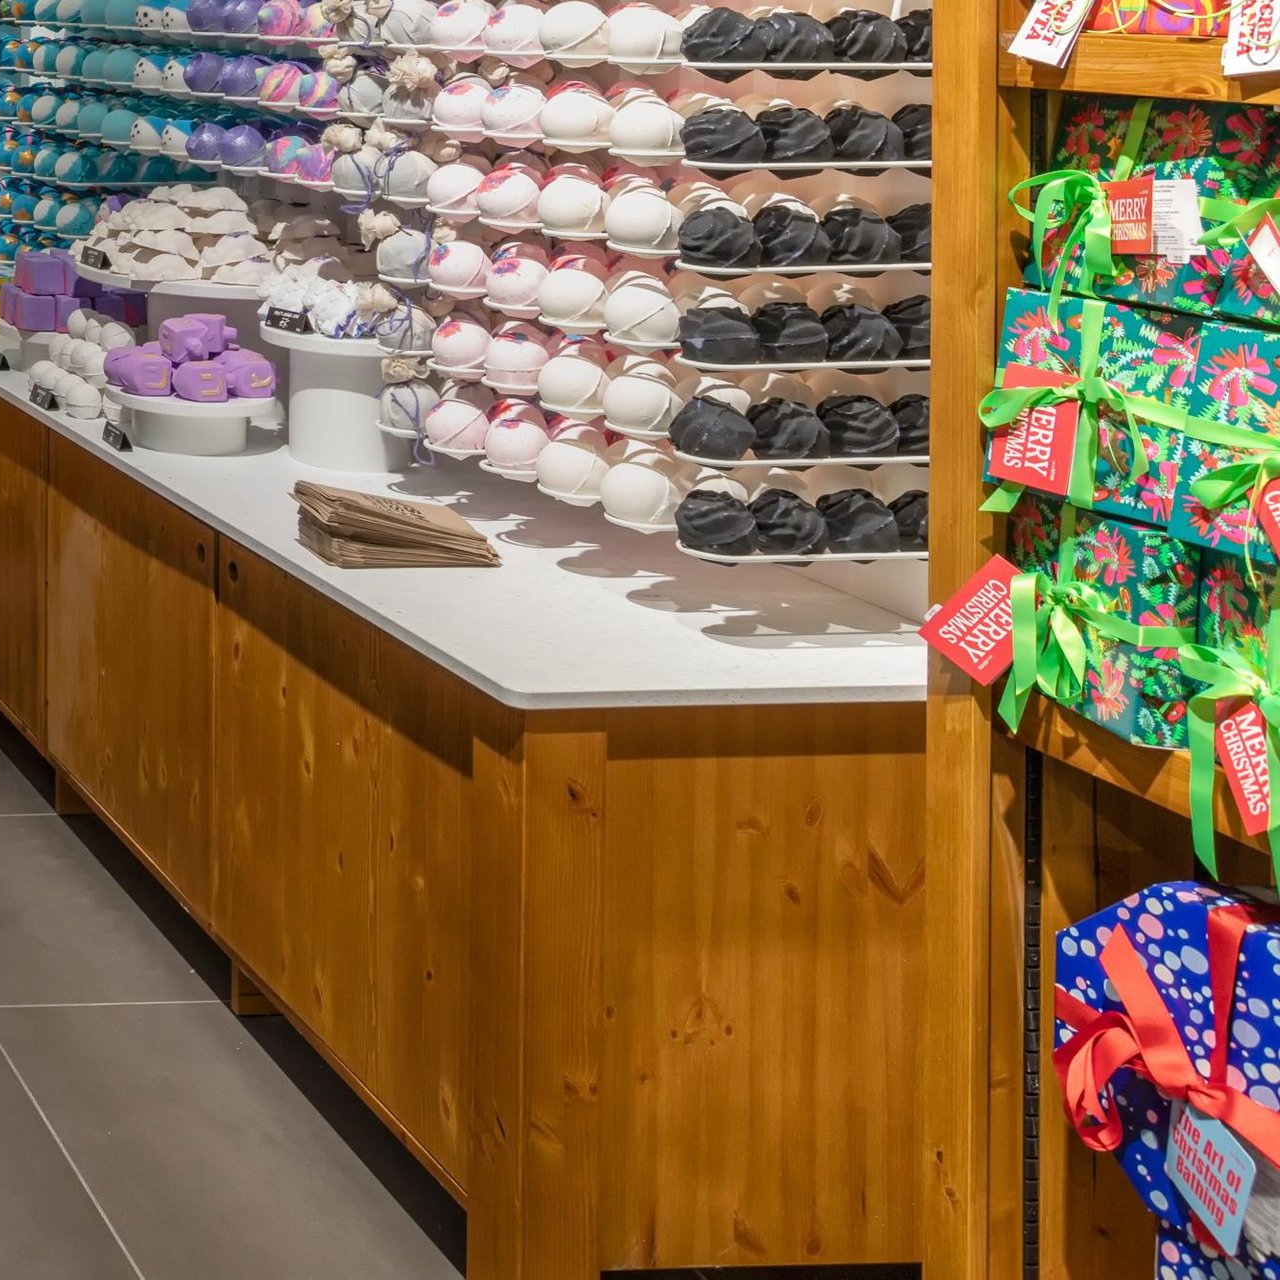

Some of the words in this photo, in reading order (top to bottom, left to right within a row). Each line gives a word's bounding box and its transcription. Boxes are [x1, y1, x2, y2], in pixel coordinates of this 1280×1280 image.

[1109, 197, 1148, 221] MERRY
[1111, 222, 1147, 241] HRISTMAS
[938, 579, 1007, 644] CHRISTMAS
[1220, 719, 1267, 816] CHRISTMAS
[1173, 1124, 1237, 1216] Christmas
[1176, 1154, 1225, 1227] Bathing
[1203, 1139, 1225, 1174] Art
[1227, 1169, 1242, 1194] of
